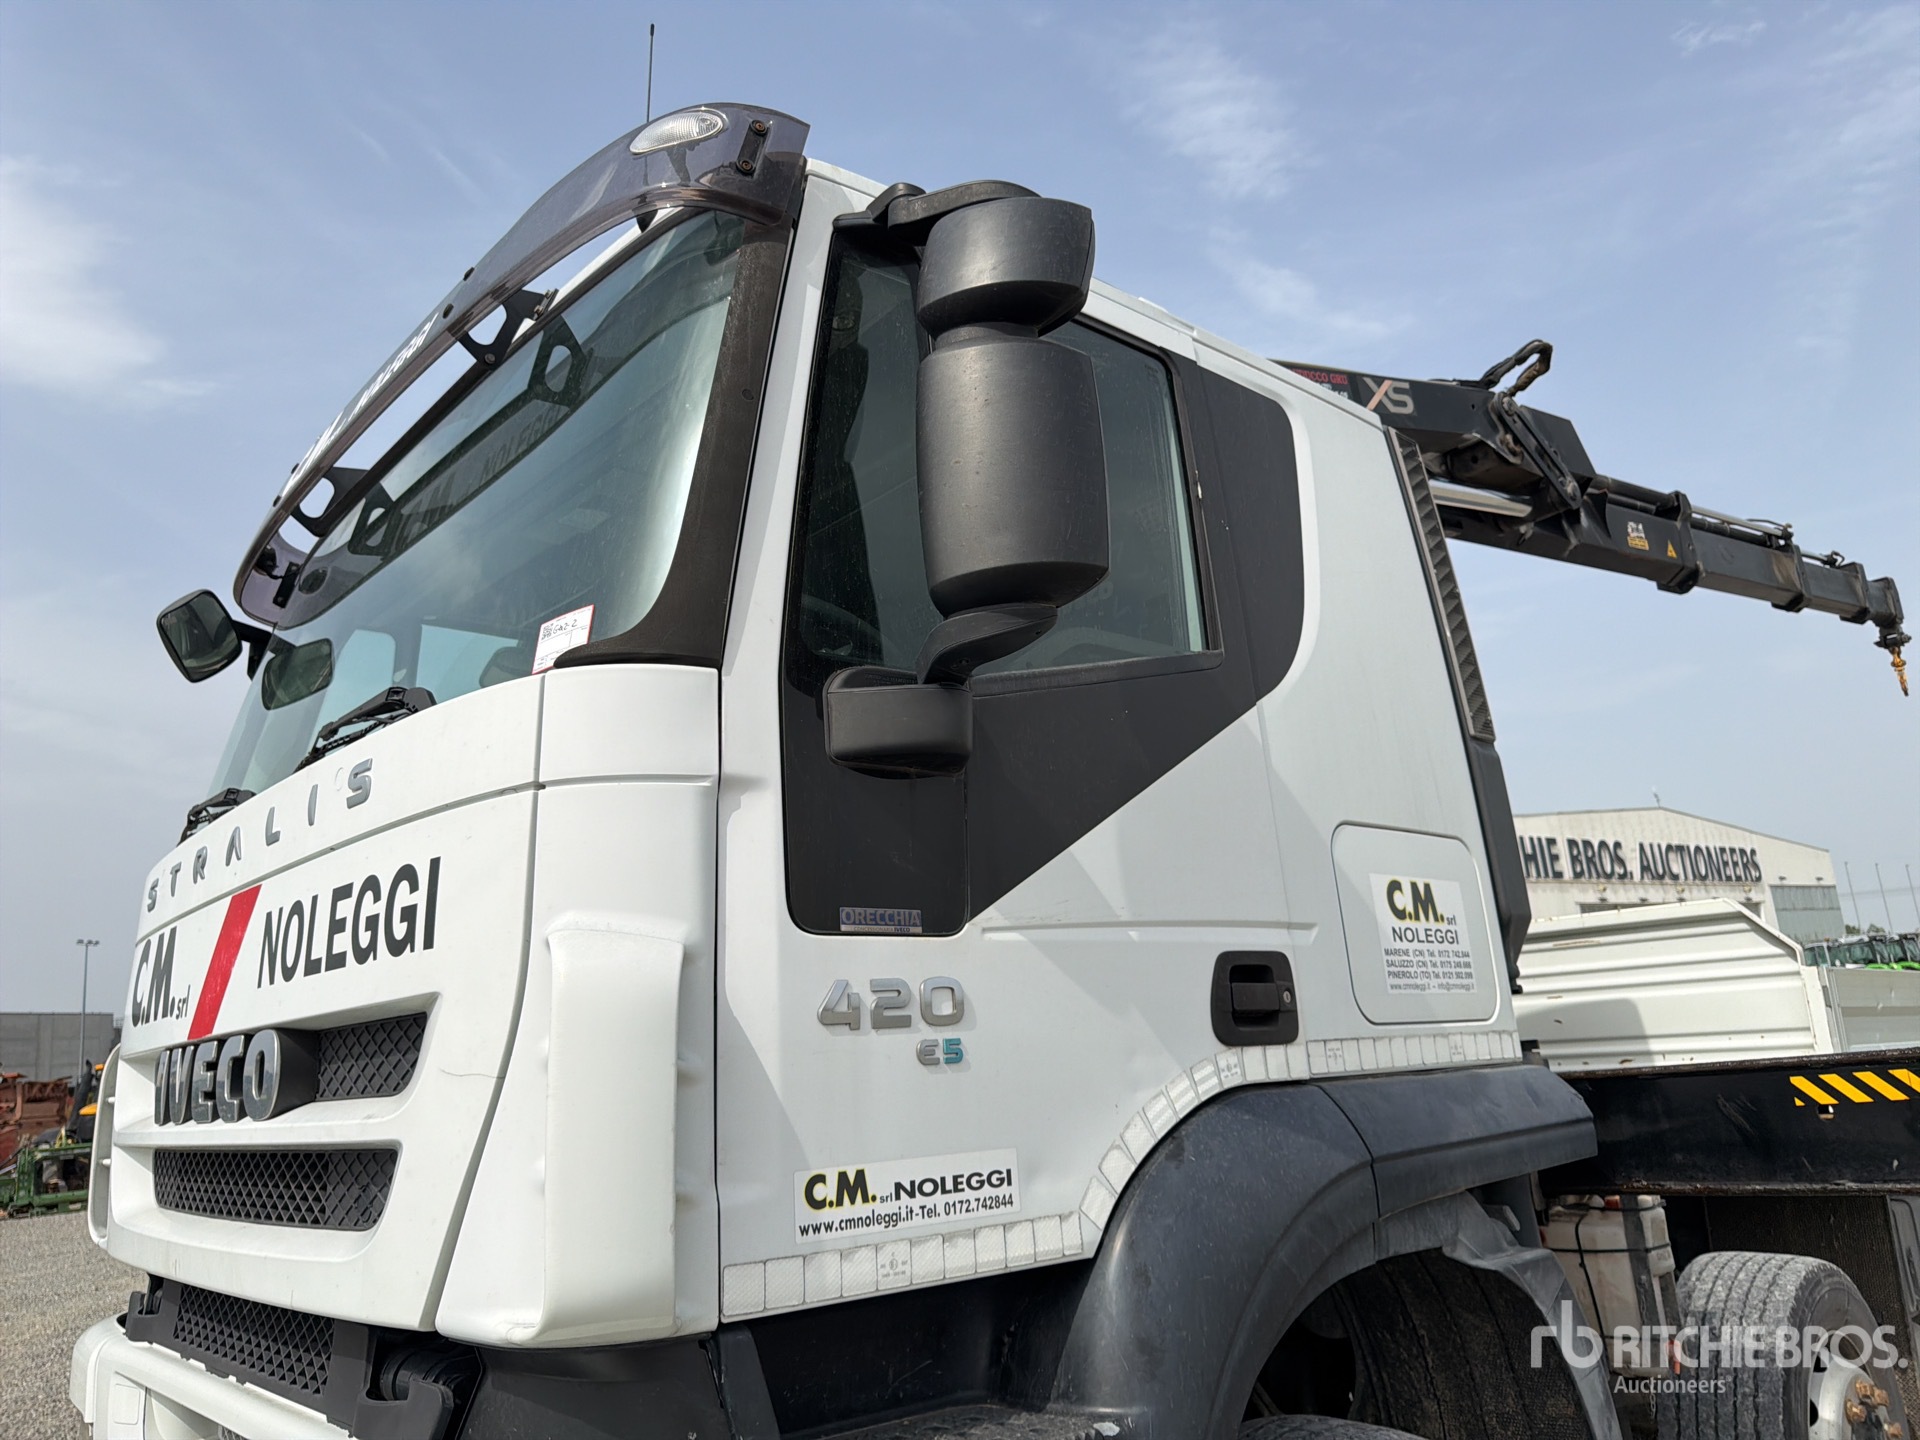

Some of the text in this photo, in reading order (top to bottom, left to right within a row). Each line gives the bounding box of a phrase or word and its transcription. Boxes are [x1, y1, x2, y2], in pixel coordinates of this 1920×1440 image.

[1362, 376, 1414, 415] XS
[145, 757, 373, 914] STRALIS
[1566, 838, 1633, 881] BROS.
[1638, 841, 1763, 883] AUCTIONEERS
[841, 908, 921, 926] ORECCHIA
[1386, 879, 1457, 926] C.M. srl
[257, 856, 442, 990] NOLEGGI
[1391, 926, 1460, 945] NOLEGGI
[1384, 948, 1410, 957] MARENE
[1412, 948, 1425, 959] (CN)
[1386, 959, 1414, 968] SALUZZO
[1416, 959, 1428, 970] (CN)
[1387, 970, 1418, 979] PINEROLO
[1419, 970, 1432, 981] (TO)
[175, 984, 191, 1021] srl
[817, 975, 965, 1031] 420
[916, 1037, 964, 1066] E5
[153, 1028, 283, 1127] IVECO
[804, 1168, 1013, 1211] C.M. srl NOLEGGI
[943, 1193, 1014, 1217] 0172.742844
